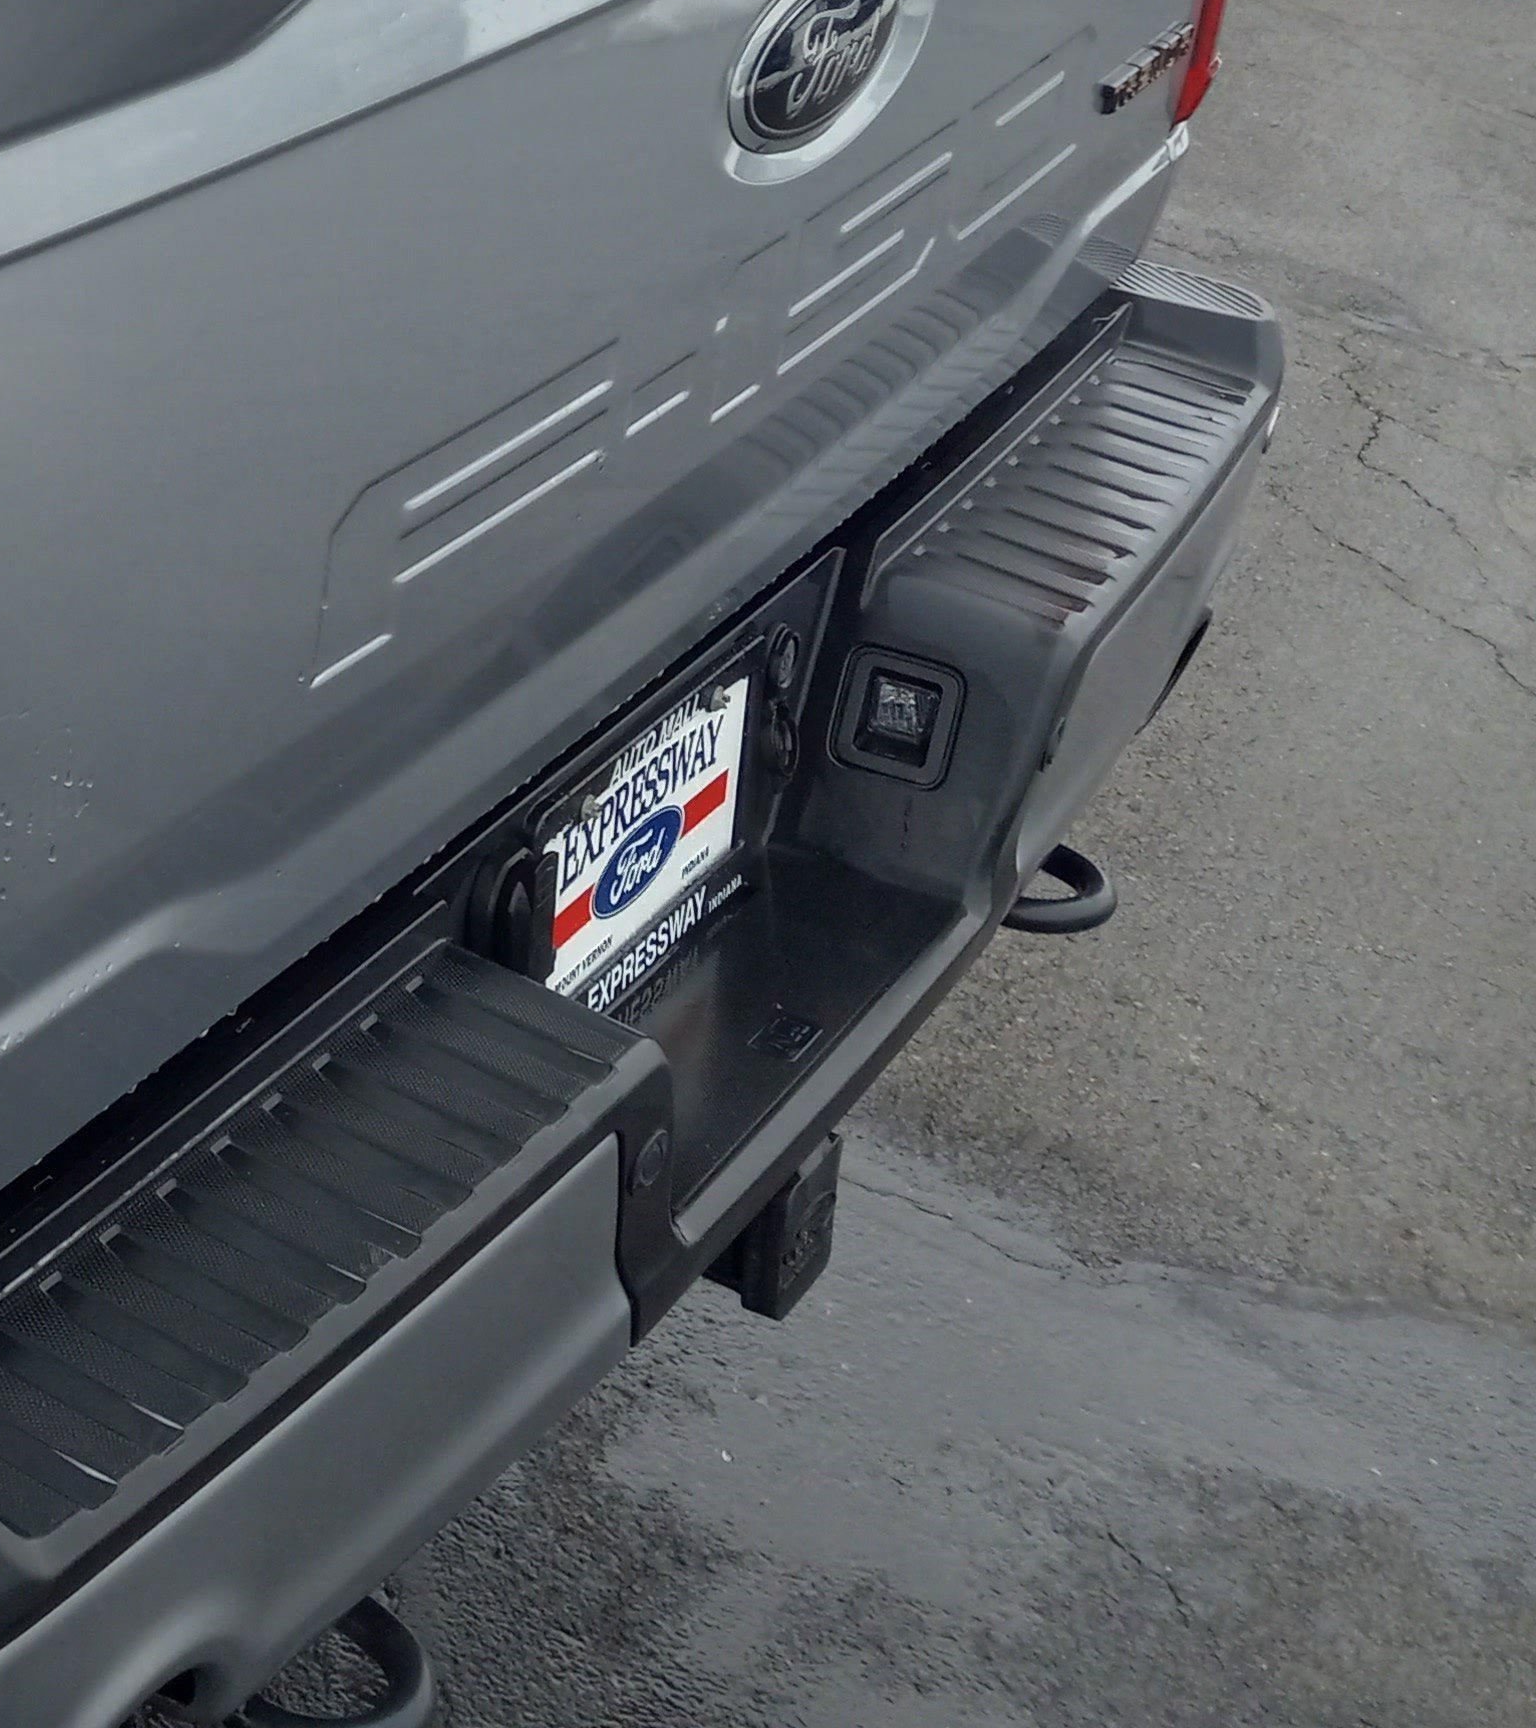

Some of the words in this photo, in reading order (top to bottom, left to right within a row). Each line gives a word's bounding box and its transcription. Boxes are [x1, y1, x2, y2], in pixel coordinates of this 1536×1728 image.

[610, 729, 657, 787] AUTO
[659, 693, 705, 746] MALL
[560, 714, 724, 895] EXPRESSWAY
[610, 827, 666, 905] Ford
[582, 936, 614, 970] VERNON
[588, 885, 707, 1012] EXPRESSWAY
[708, 873, 743, 913] INDIANA
